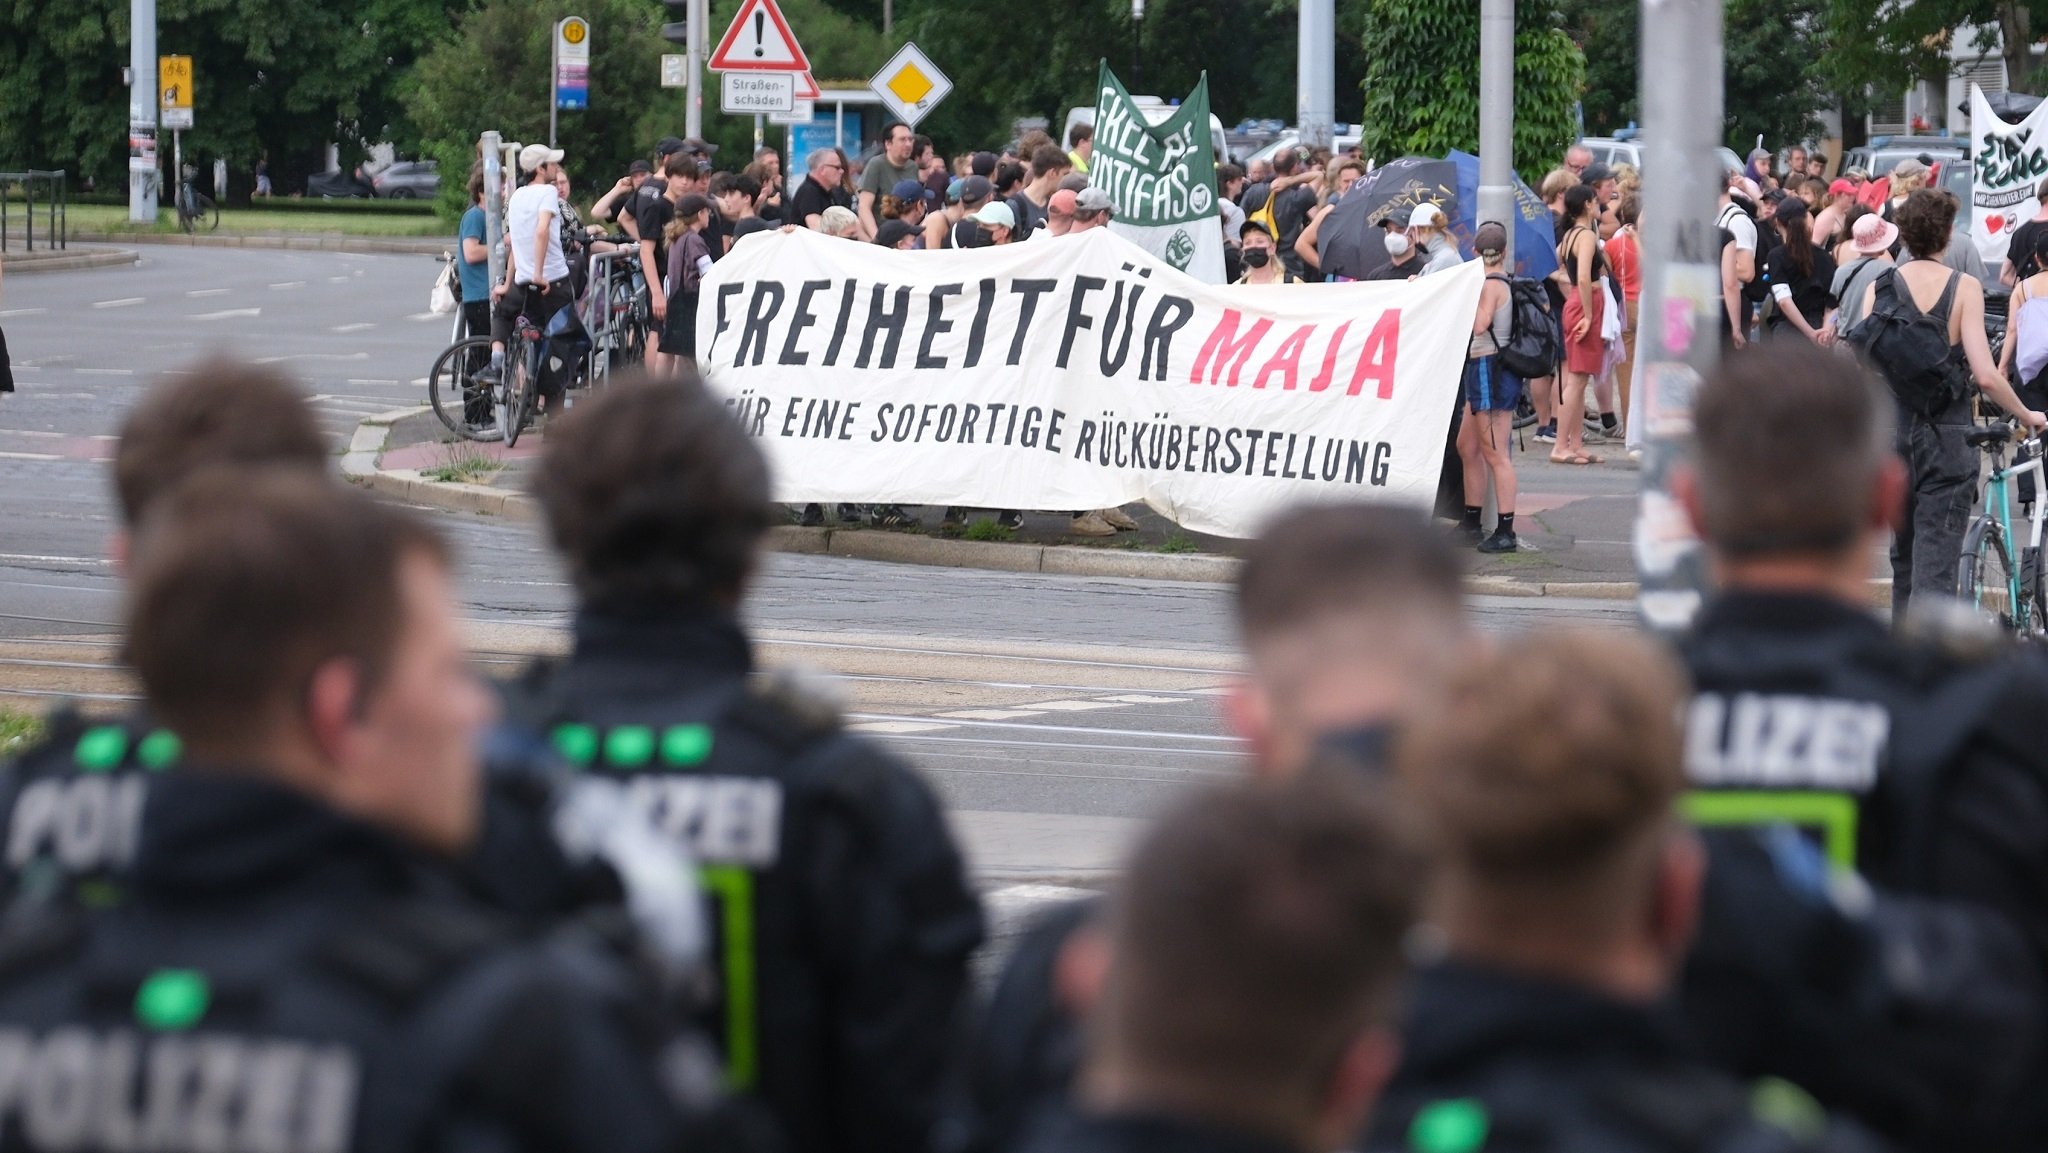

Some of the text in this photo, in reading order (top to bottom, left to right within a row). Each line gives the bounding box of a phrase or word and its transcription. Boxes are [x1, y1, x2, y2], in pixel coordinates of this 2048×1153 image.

[732, 78, 785, 91] Straßen-
[734, 93, 783, 105] schäden
[706, 262, 1402, 400] FREIHEIT FÜR MAJA
[780, 396, 861, 441] EINE
[870, 402, 1066, 454] SOFORTIGE
[1074, 411, 1392, 487] RÜCKÜBERSTELLUNG
[1682, 690, 1891, 793] LIZEI
